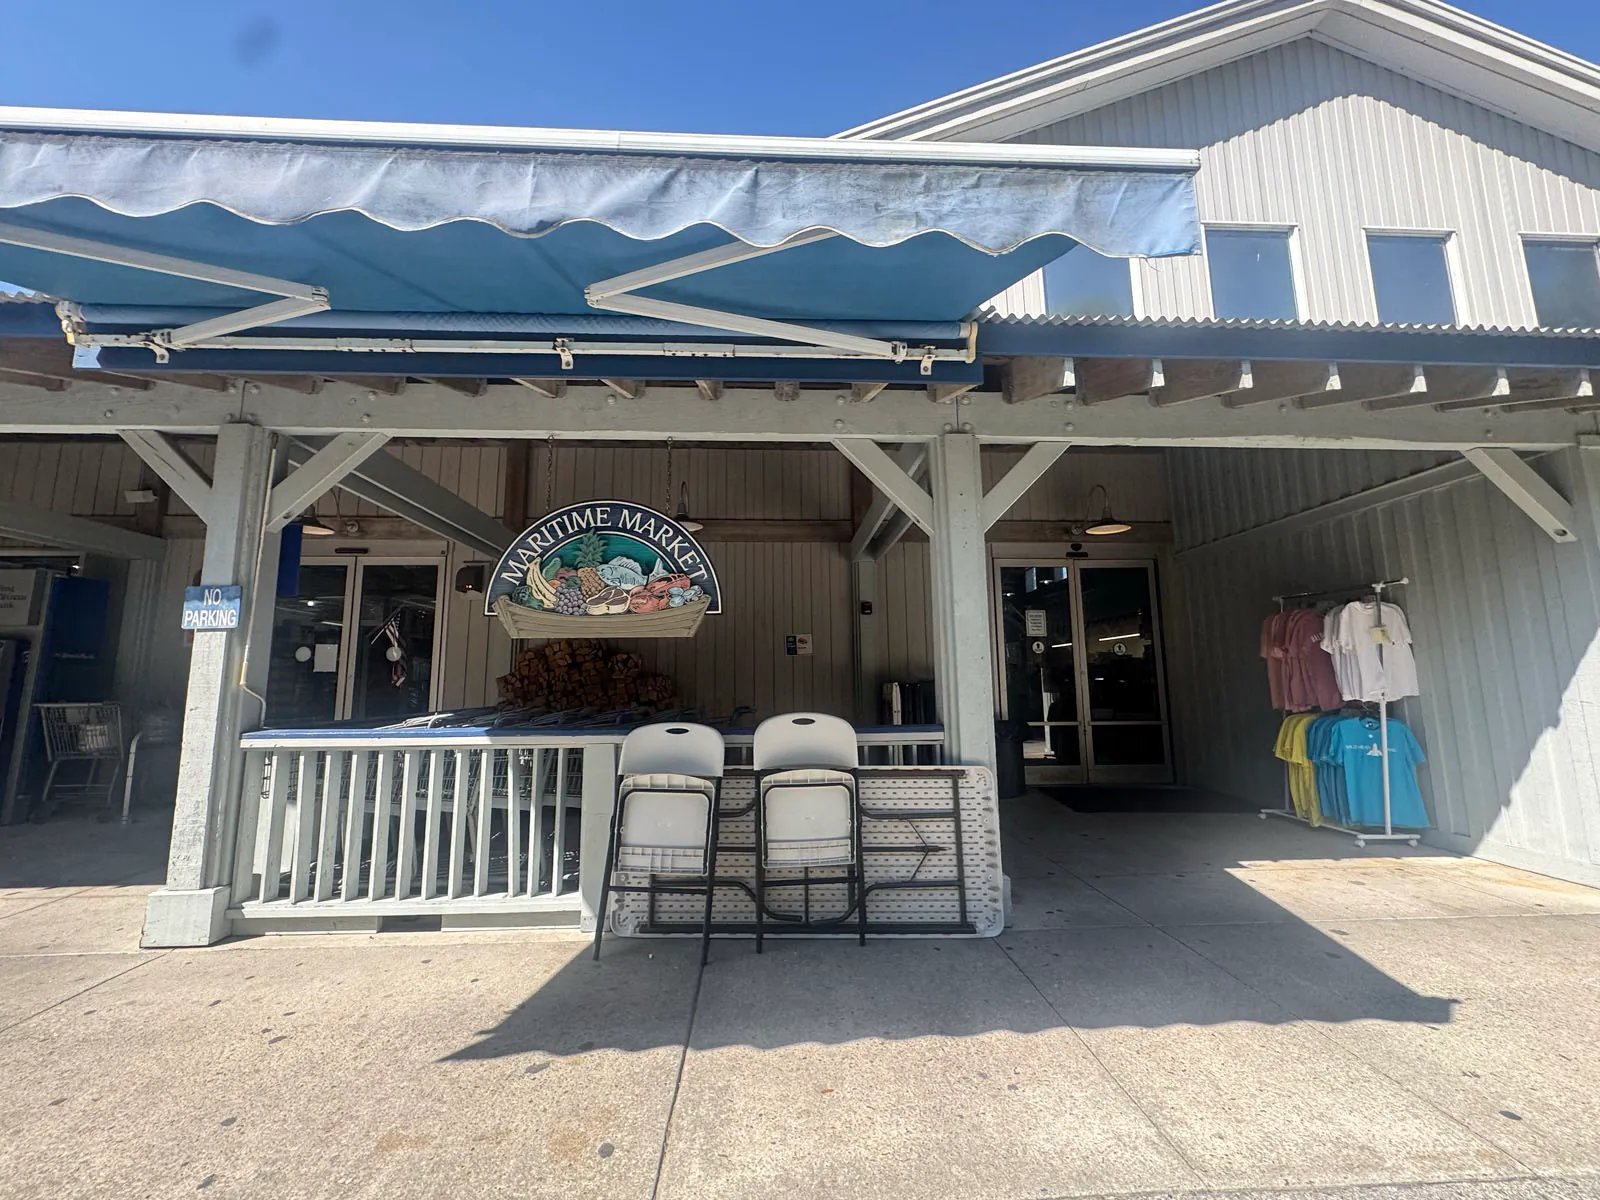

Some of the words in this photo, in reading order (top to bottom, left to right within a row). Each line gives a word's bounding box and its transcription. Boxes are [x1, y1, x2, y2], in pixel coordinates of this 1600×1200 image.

[500, 507, 612, 586] MARITIME
[618, 508, 710, 582] MARKET
[203, 588, 222, 606] NO
[183, 609, 237, 627] PARKING
